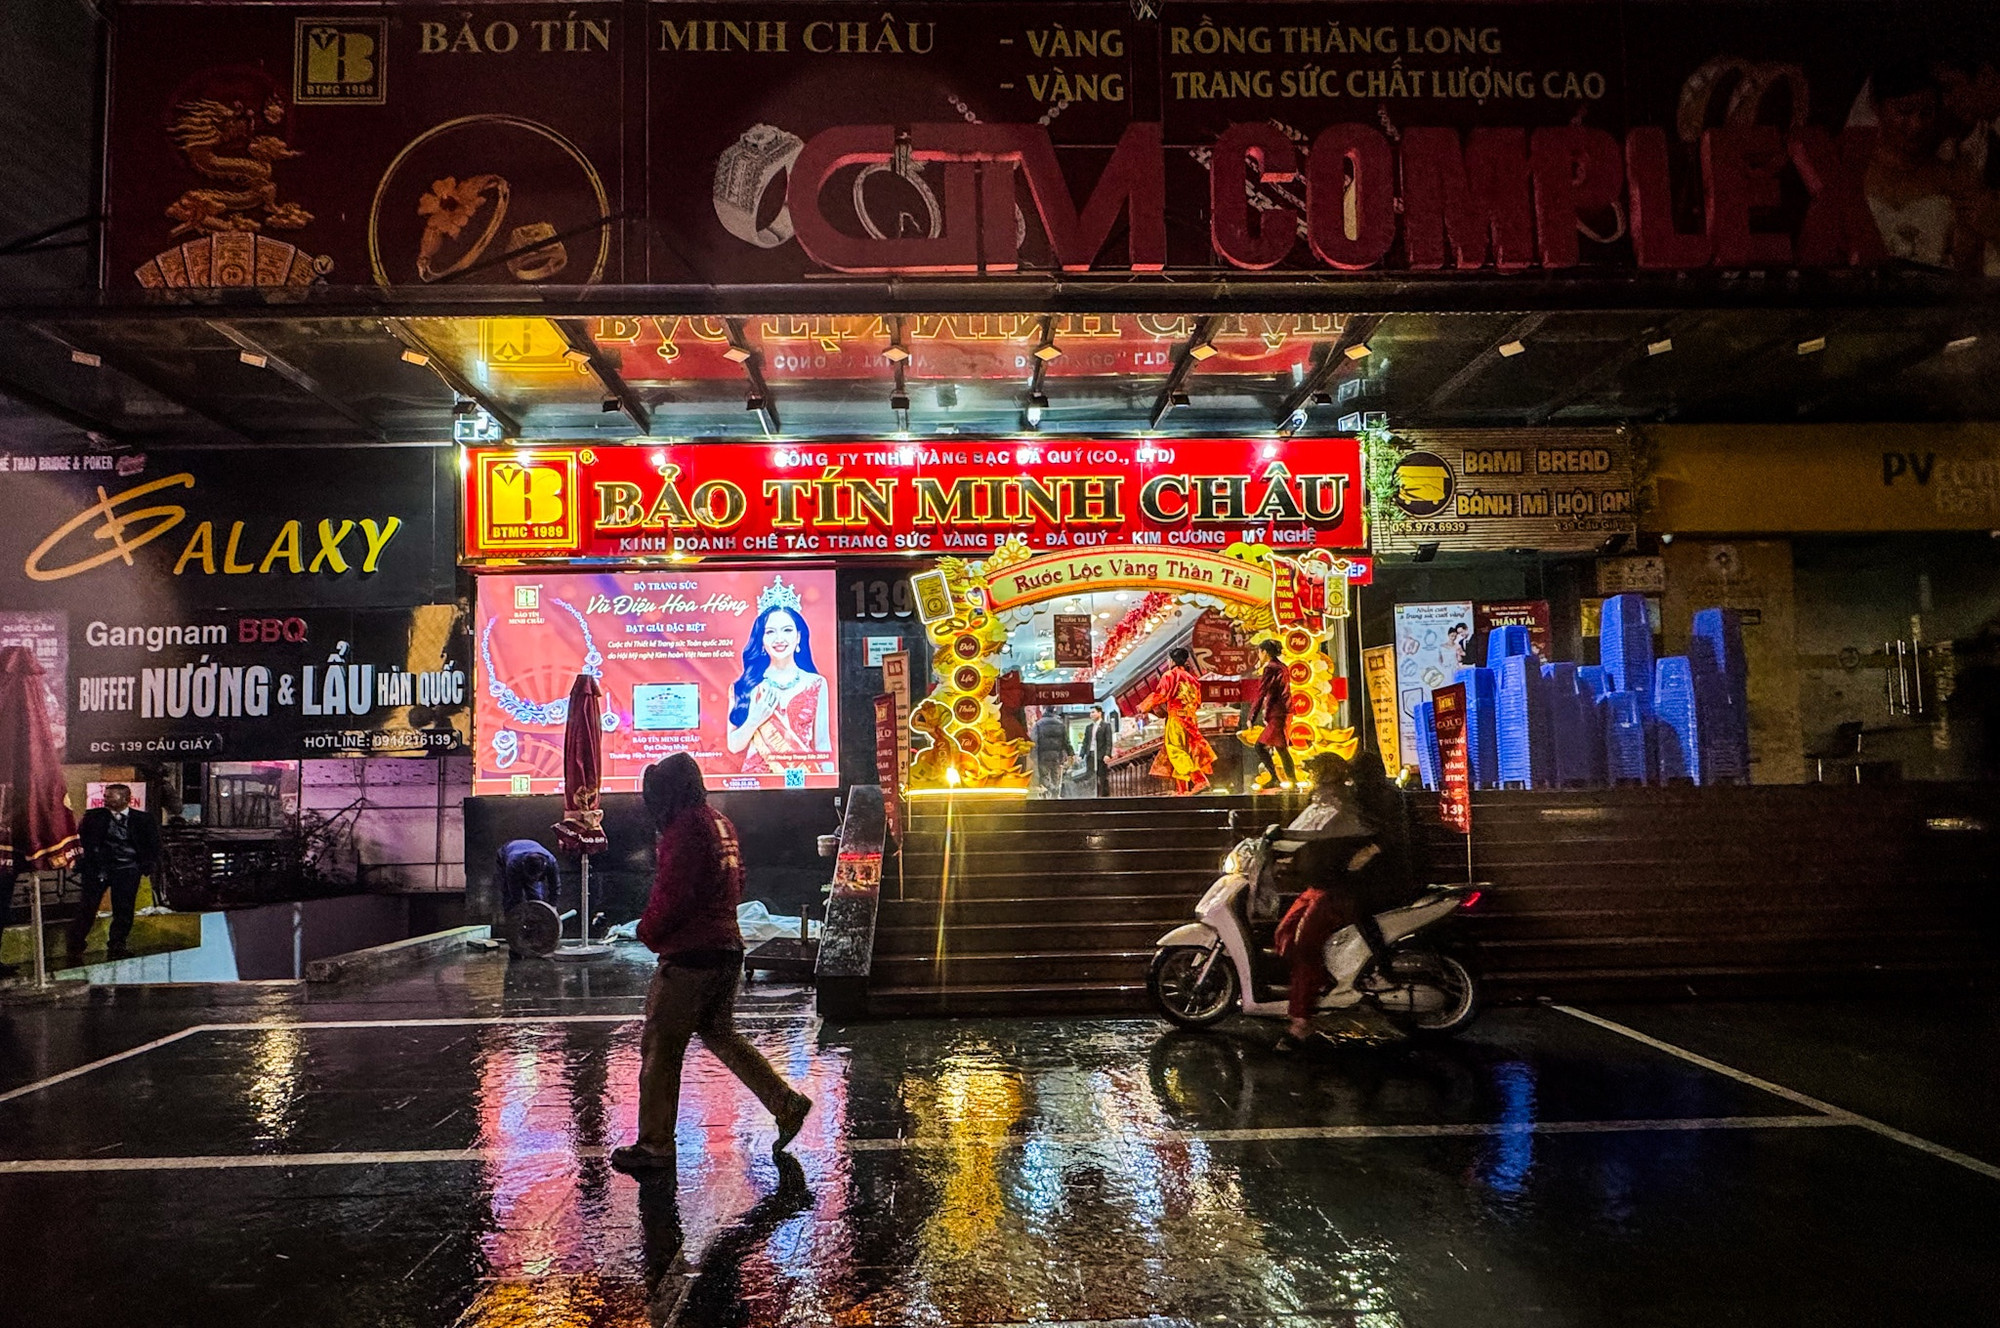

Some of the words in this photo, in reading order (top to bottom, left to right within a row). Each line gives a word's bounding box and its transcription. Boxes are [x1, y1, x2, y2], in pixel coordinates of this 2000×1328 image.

[420, 12, 519, 53] BẢO
[531, 11, 611, 53] TÍN
[660, 20, 790, 54] MINH
[803, 13, 936, 54] CHÂU
[1026, 23, 1124, 58] VÀNG
[1170, 14, 1272, 54] RỒNG
[1279, 20, 1397, 54] THĂNG
[1406, 26, 1502, 54] LONG
[306, 84, 341, 96] BTMC
[345, 84, 374, 96] 1989
[1026, 67, 1124, 103] VÀNG
[1170, 70, 1273, 99] TRANG
[1280, 63, 1341, 99] SỨC
[1346, 57, 1425, 98] CHẤT
[1432, 66, 1536, 105] LƯỢNG
[1543, 71, 1606, 100] CAO
[1210, 121, 1889, 273] COMPLEX
[837, 452, 858, 466] TY
[917, 449, 968, 466] VÀNG
[1047, 447, 1084, 464] QUÝ
[1463, 450, 1522, 474] BAMI
[1537, 449, 1610, 473] BREAD
[594, 463, 747, 529] BẢO
[762, 465, 898, 528] TÍN
[912, 474, 1125, 526] MINH
[1139, 460, 1350, 523] CHÂU
[1456, 489, 1513, 516] BÁNH
[1520, 489, 1549, 516] MÌ
[1555, 489, 1594, 520] HỘI
[1601, 492, 1632, 513] AN
[25, 472, 401, 582] GALAXY
[492, 526, 528, 538] BTMC
[532, 526, 564, 538] 1989
[620, 536, 666, 550] KINH
[673, 536, 737, 550] DOANH
[784, 532, 820, 549] TÁC
[827, 534, 888, 548] TRANG
[894, 530, 931, 548] SỨC
[943, 530, 987, 547] VÀNG
[1045, 530, 1068, 546] ĐÁ
[1073, 530, 1108, 546] QUÝ
[1132, 531, 1161, 545] KIM
[1168, 530, 1226, 545] CƯƠNG
[1242, 527, 1266, 543] MỸ
[1272, 527, 1317, 545] NGHỆ
[648, 582, 677, 591] TRANG
[1013, 567, 1063, 593] Rước
[1069, 563, 1103, 582] Lộc
[1108, 559, 1159, 579] Vàng
[1166, 560, 1213, 582] Thần
[1221, 567, 1251, 591] Tài
[586, 594, 611, 615] Vũ
[613, 595, 657, 617] Điệu
[659, 593, 699, 615] Hoa
[701, 593, 750, 617] Hồng
[850, 580, 912, 618] 139
[86, 621, 228, 652] Gangnam
[238, 617, 308, 643] BBQ
[79, 676, 136, 712] BUFFET
[141, 654, 269, 718] NƯỚNG
[277, 673, 295, 706] &
[302, 640, 372, 716] LẨU
[377, 664, 412, 706] HÀN
[419, 659, 465, 708] QUỐC
[1051, 690, 1070, 699] 1989
[90, 741, 115, 752] ĐC:
[120, 741, 143, 752] 139
[305, 734, 371, 748] HOTLINE:
